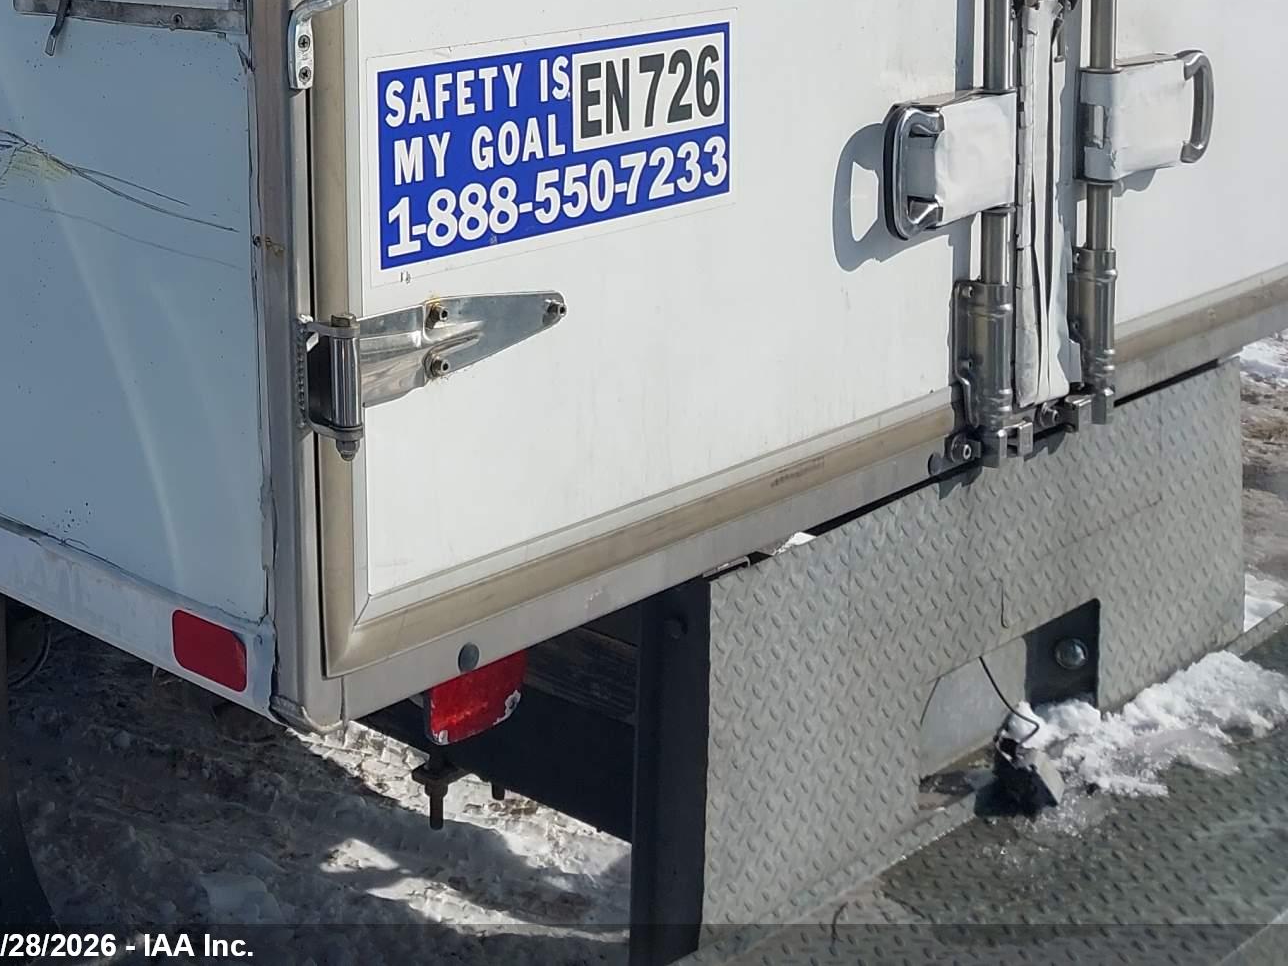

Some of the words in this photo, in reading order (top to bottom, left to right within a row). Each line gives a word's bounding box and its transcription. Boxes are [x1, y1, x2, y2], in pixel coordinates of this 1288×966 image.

[385, 63, 523, 127] SAFETY
[540, 56, 570, 102] IS
[394, 132, 451, 185] MY
[472, 114, 565, 170] GOAL
[388, 136, 727, 257] 1-888-550-7233
